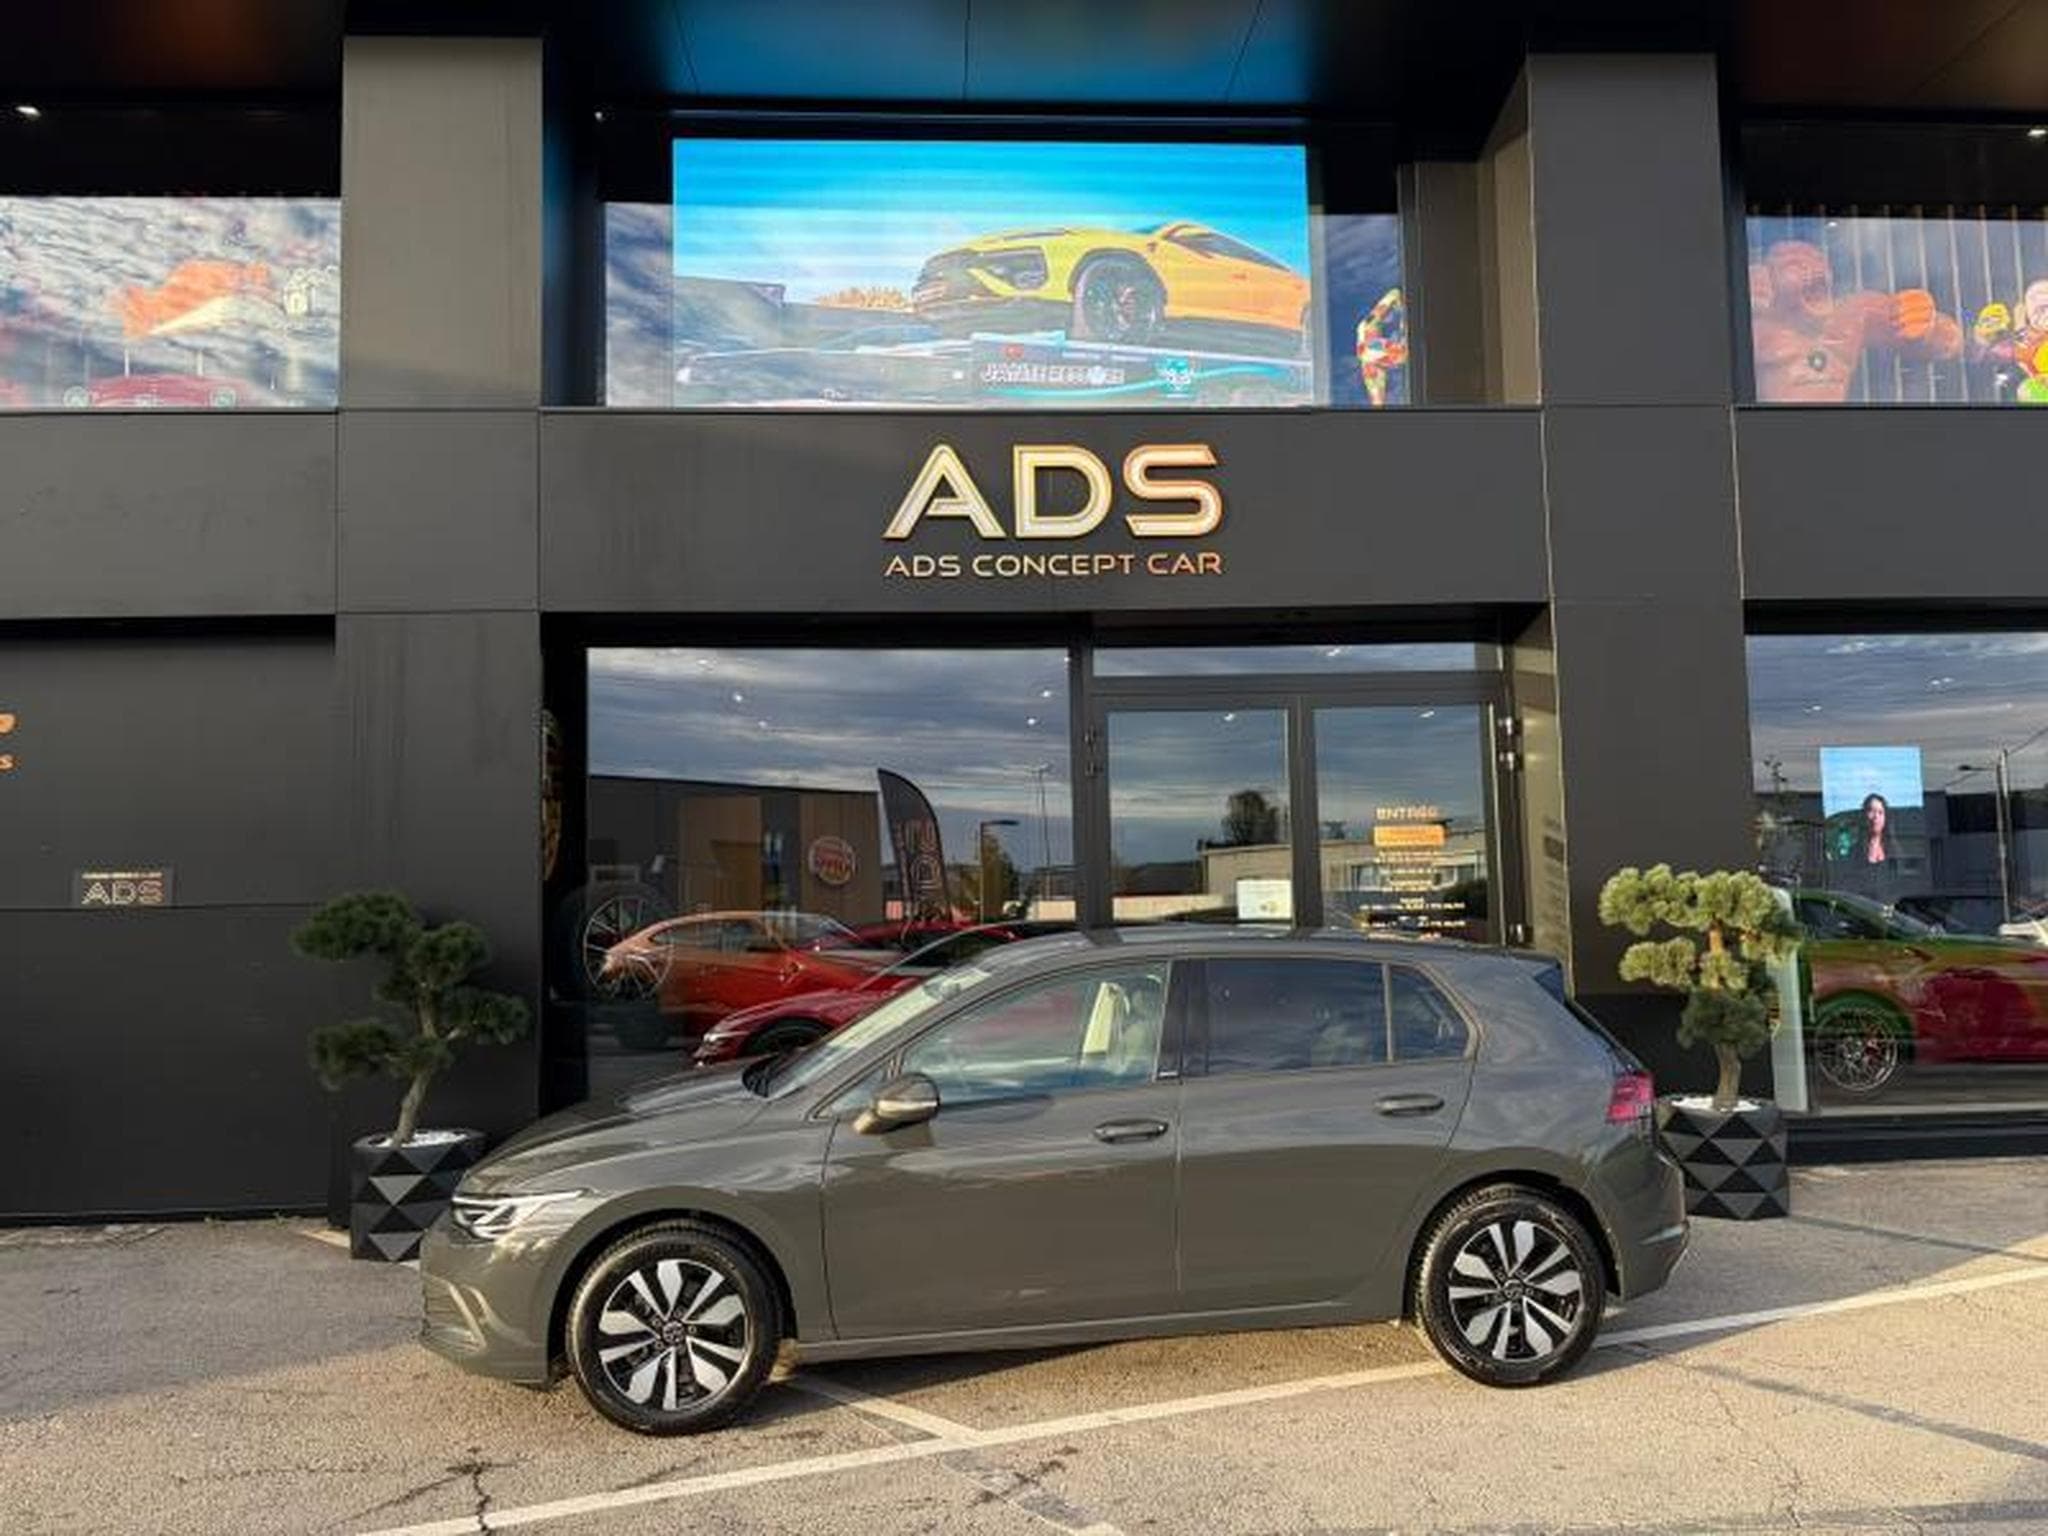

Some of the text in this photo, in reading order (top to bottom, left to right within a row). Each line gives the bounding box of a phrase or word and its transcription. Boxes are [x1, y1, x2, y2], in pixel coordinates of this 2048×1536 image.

[882, 443, 1223, 539] ADS
[884, 552, 1223, 577] ADS CONCEPT CAR
[81, 880, 163, 905] ADS
